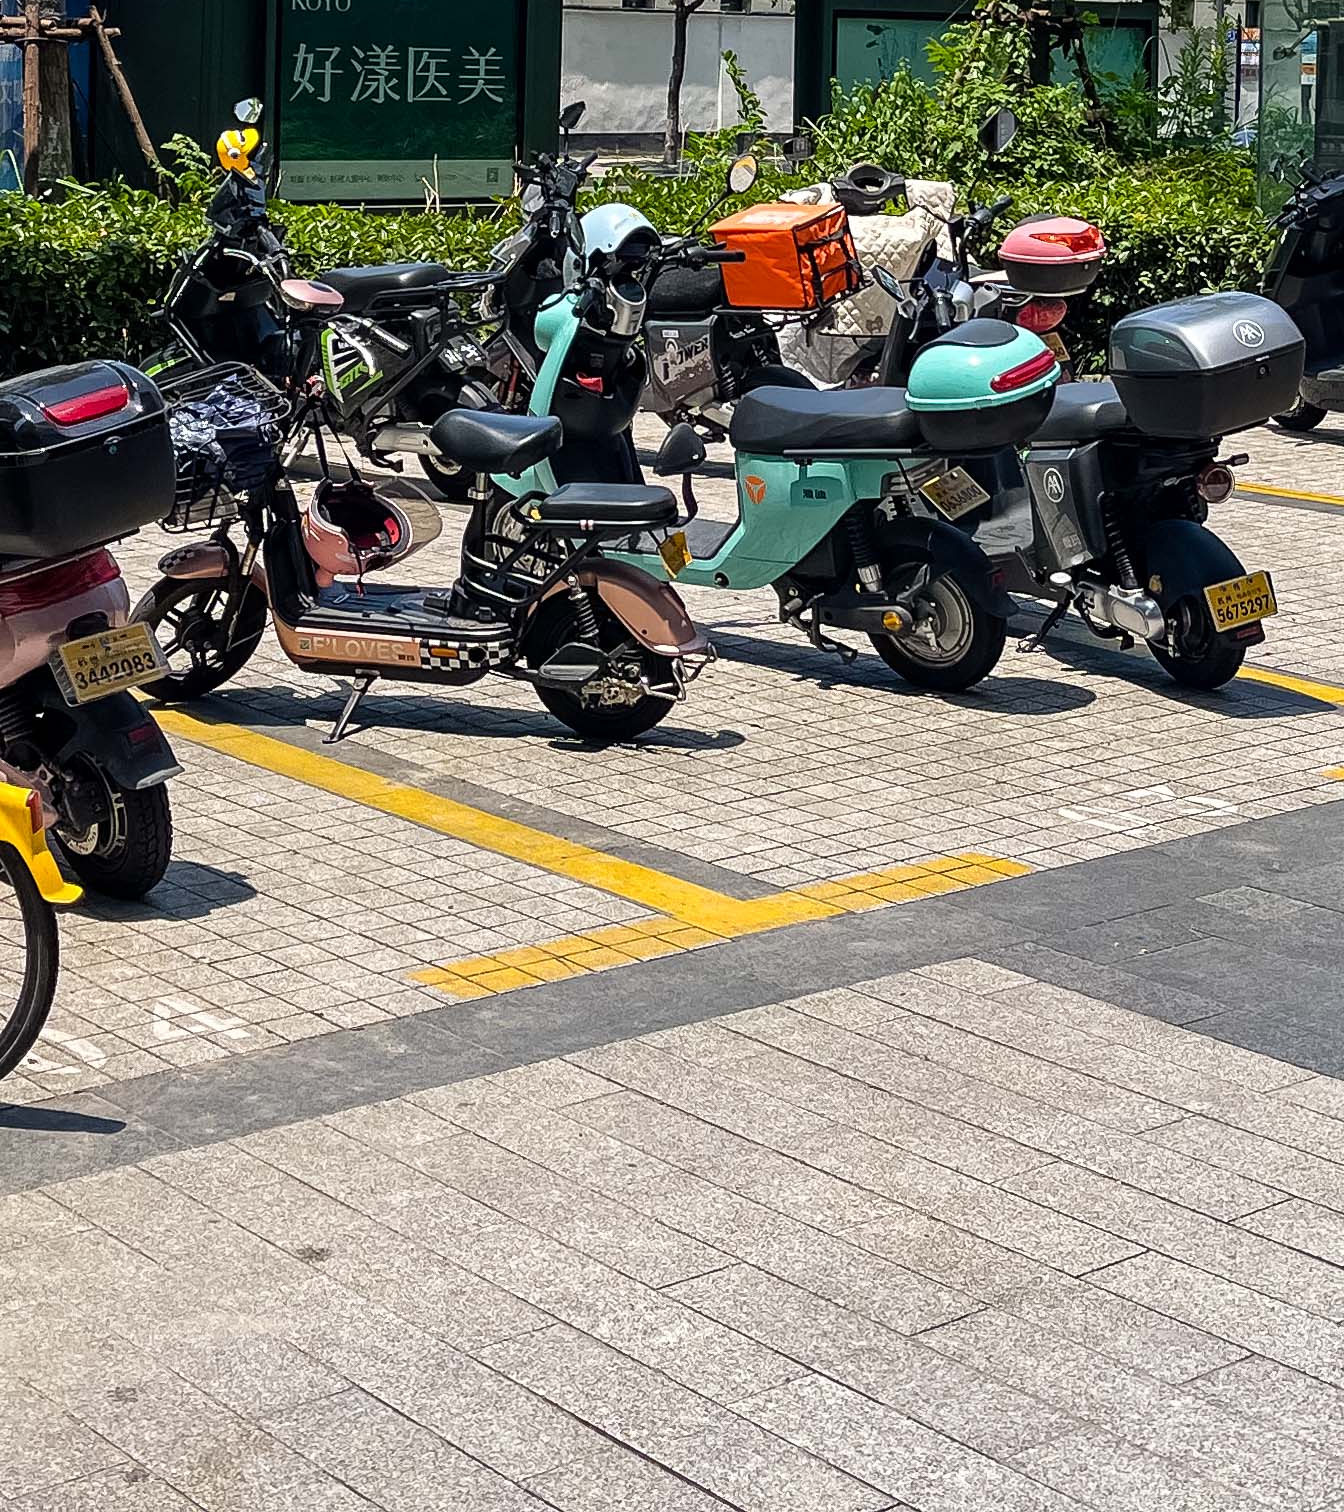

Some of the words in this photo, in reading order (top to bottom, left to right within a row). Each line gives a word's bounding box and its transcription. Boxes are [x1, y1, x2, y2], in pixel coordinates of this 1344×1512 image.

[289, 43, 506, 105] 好漾医美
[1217, 593, 1270, 624] 5675297
[75, 651, 156, 690] 3442083
